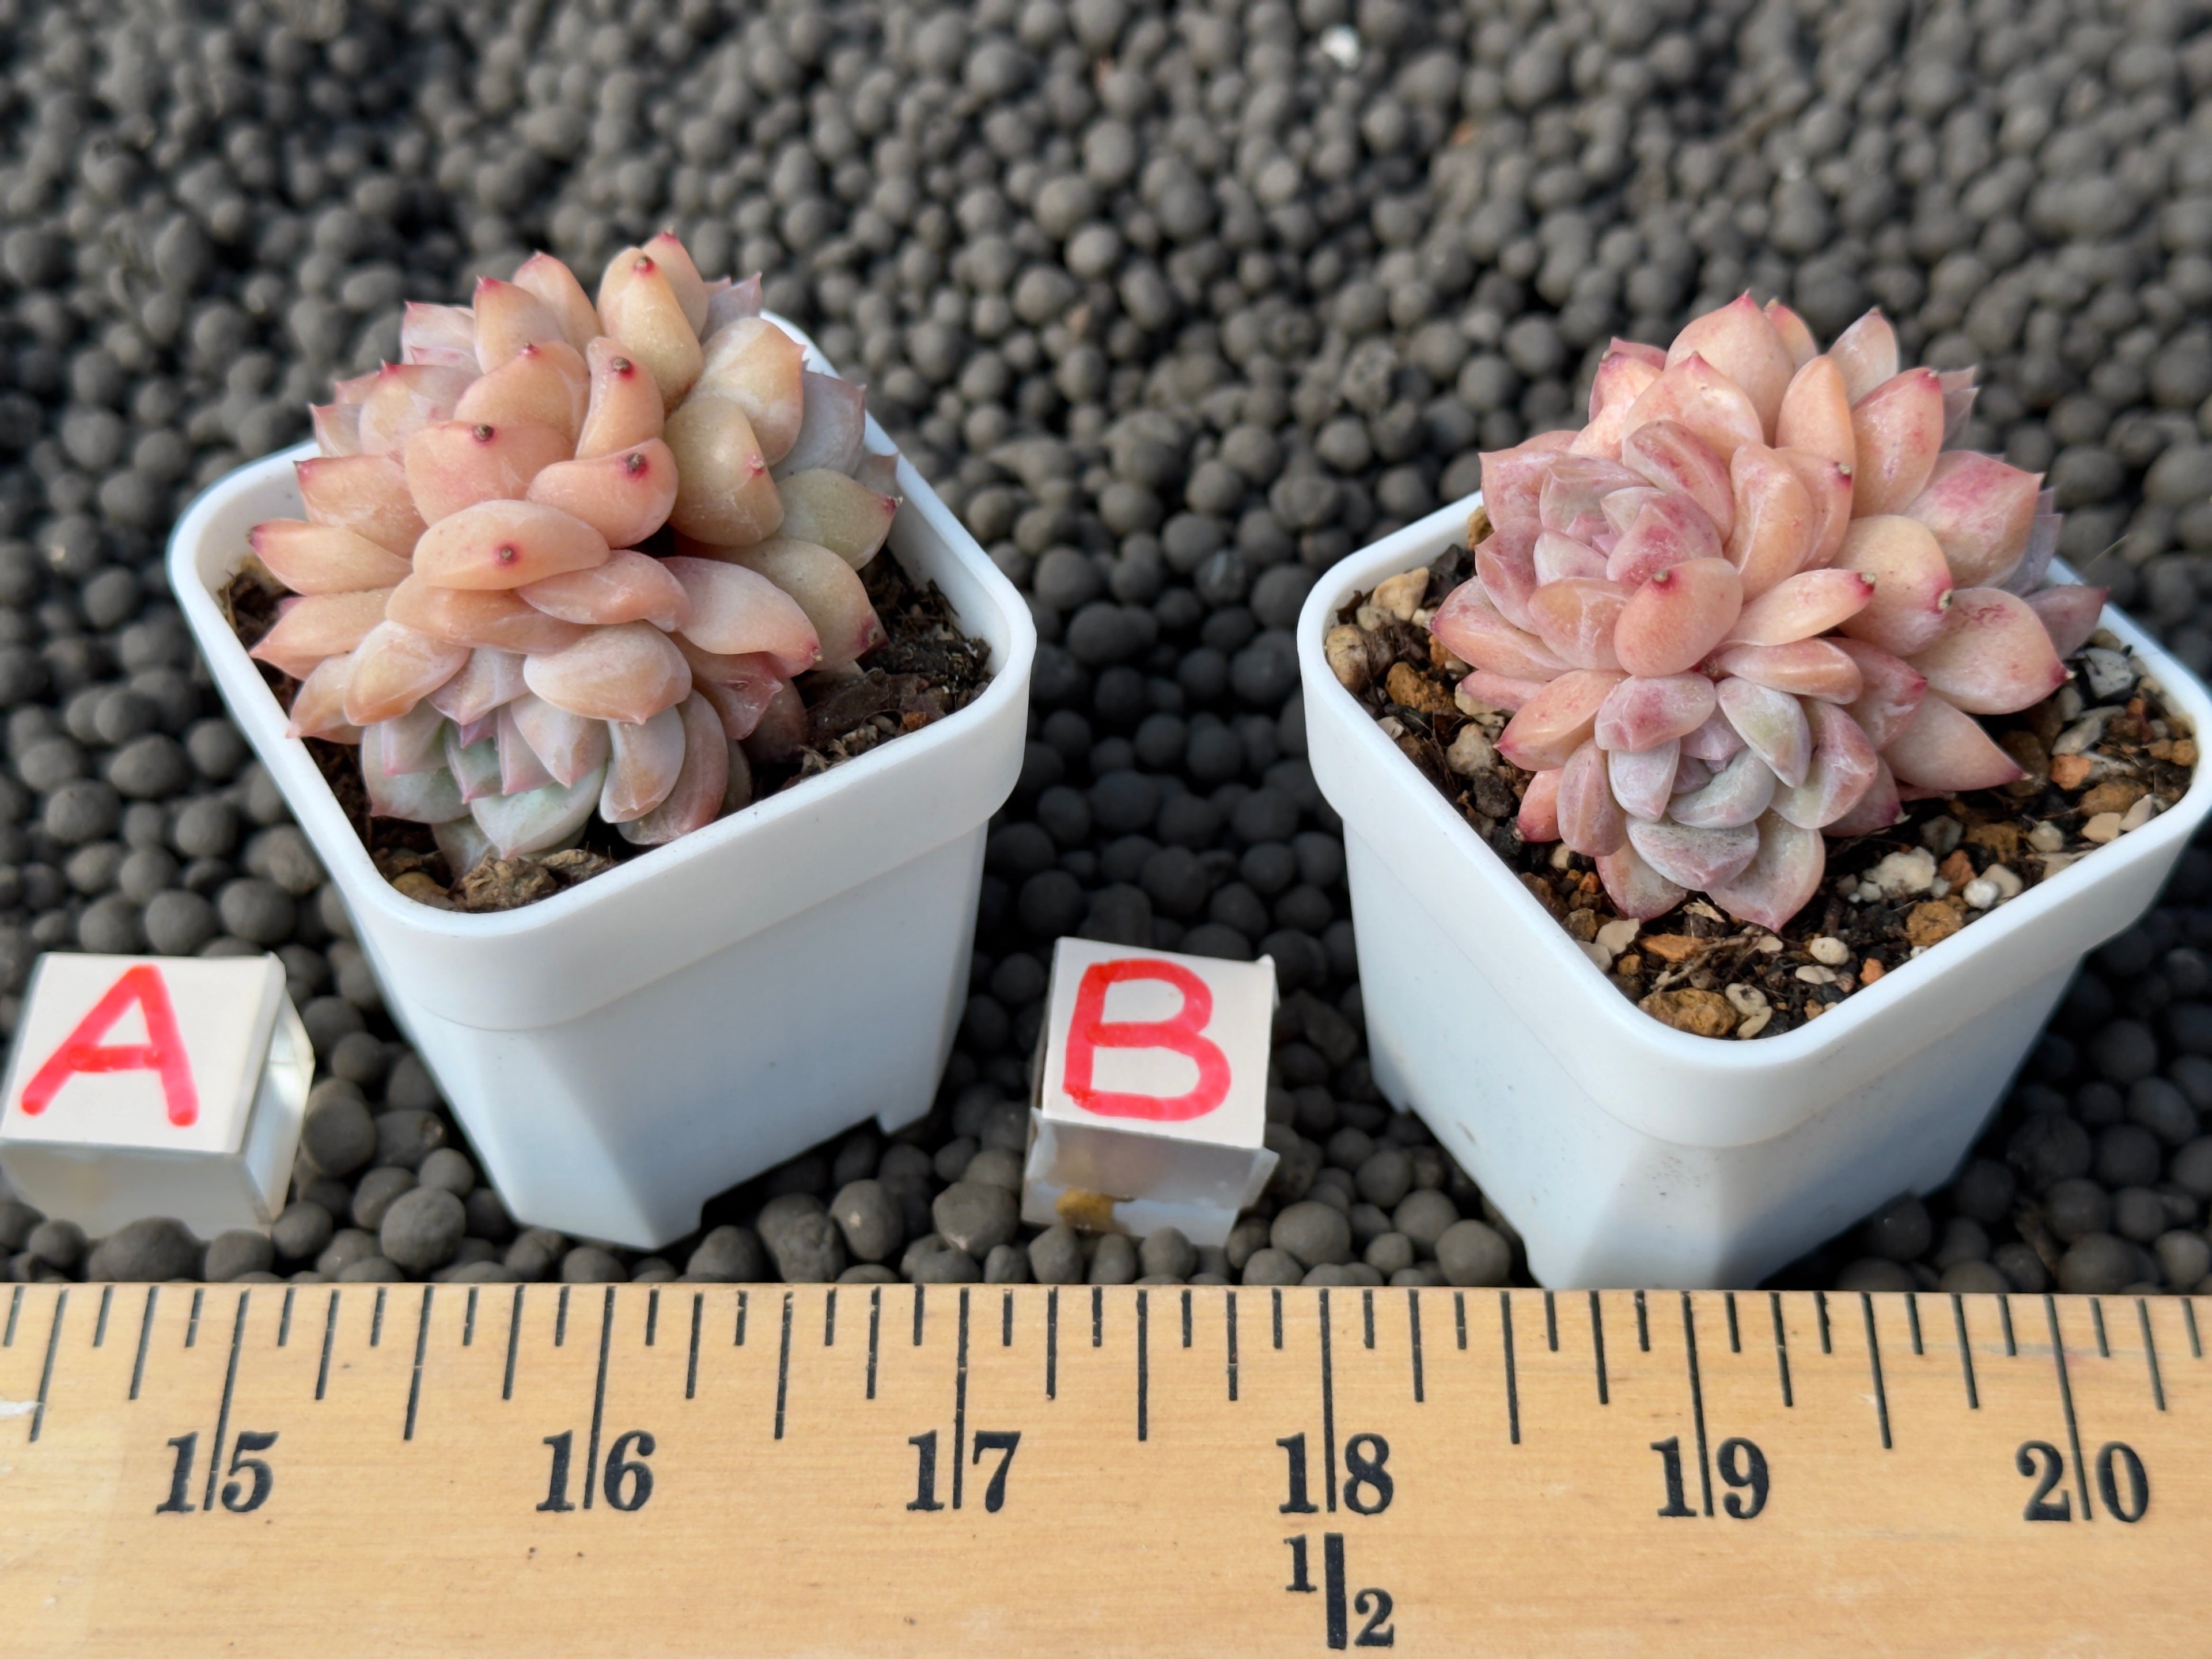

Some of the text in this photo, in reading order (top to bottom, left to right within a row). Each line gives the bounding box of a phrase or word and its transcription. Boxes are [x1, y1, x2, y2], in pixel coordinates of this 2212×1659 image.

[21, 963, 200, 1127] A
[1062, 957, 1232, 1122] B
[156, 1430, 279, 1514] 15
[536, 1429, 656, 1512] 16
[906, 1429, 1021, 1513] 17
[1275, 1431, 1395, 1516] 18
[1650, 1435, 1770, 1520] 19
[2015, 1440, 2149, 1523] 20
